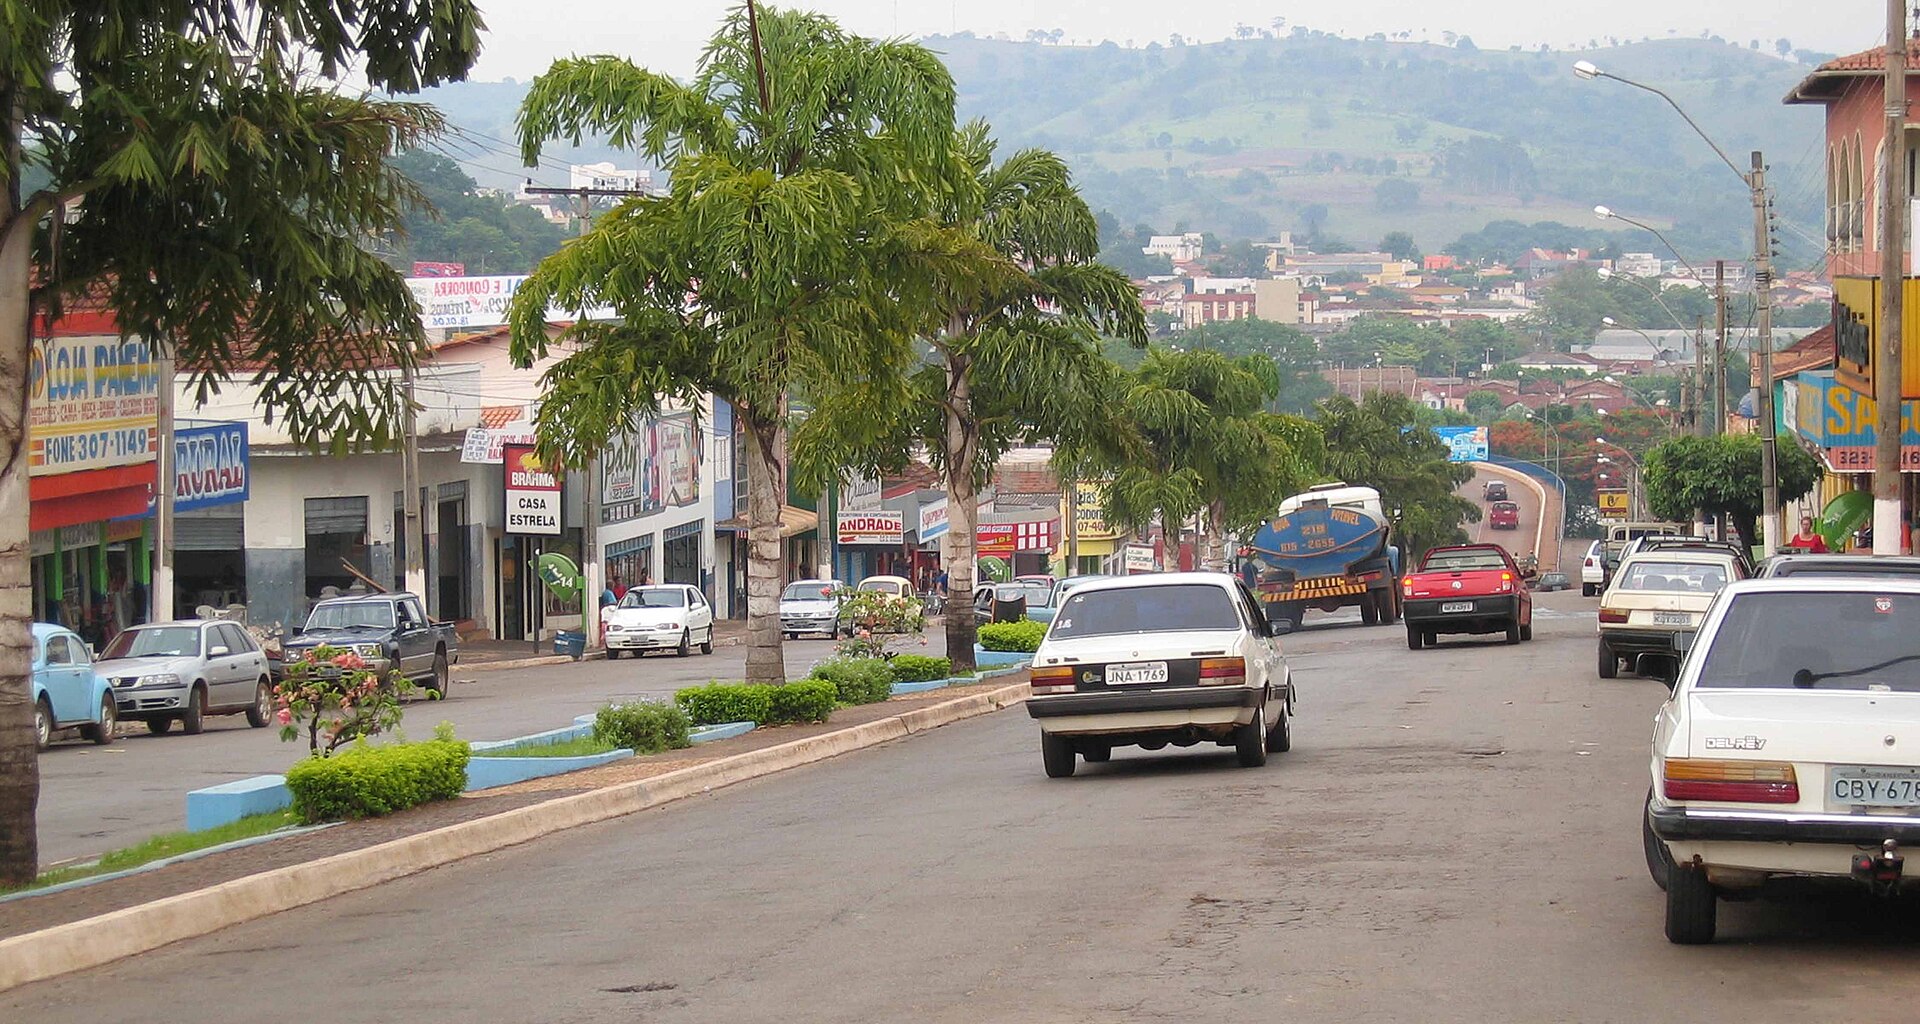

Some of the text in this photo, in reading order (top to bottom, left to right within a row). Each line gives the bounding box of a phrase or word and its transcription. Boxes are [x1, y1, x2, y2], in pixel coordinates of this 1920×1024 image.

[47, 345, 89, 402] LOJA
[45, 435, 76, 466] FONE
[174, 431, 245, 502] RURAL
[511, 471, 556, 487] BRAHMA
[518, 497, 547, 510] CASA
[510, 513, 556, 527] ESTRELA
[839, 518, 902, 531] ANDRADE
